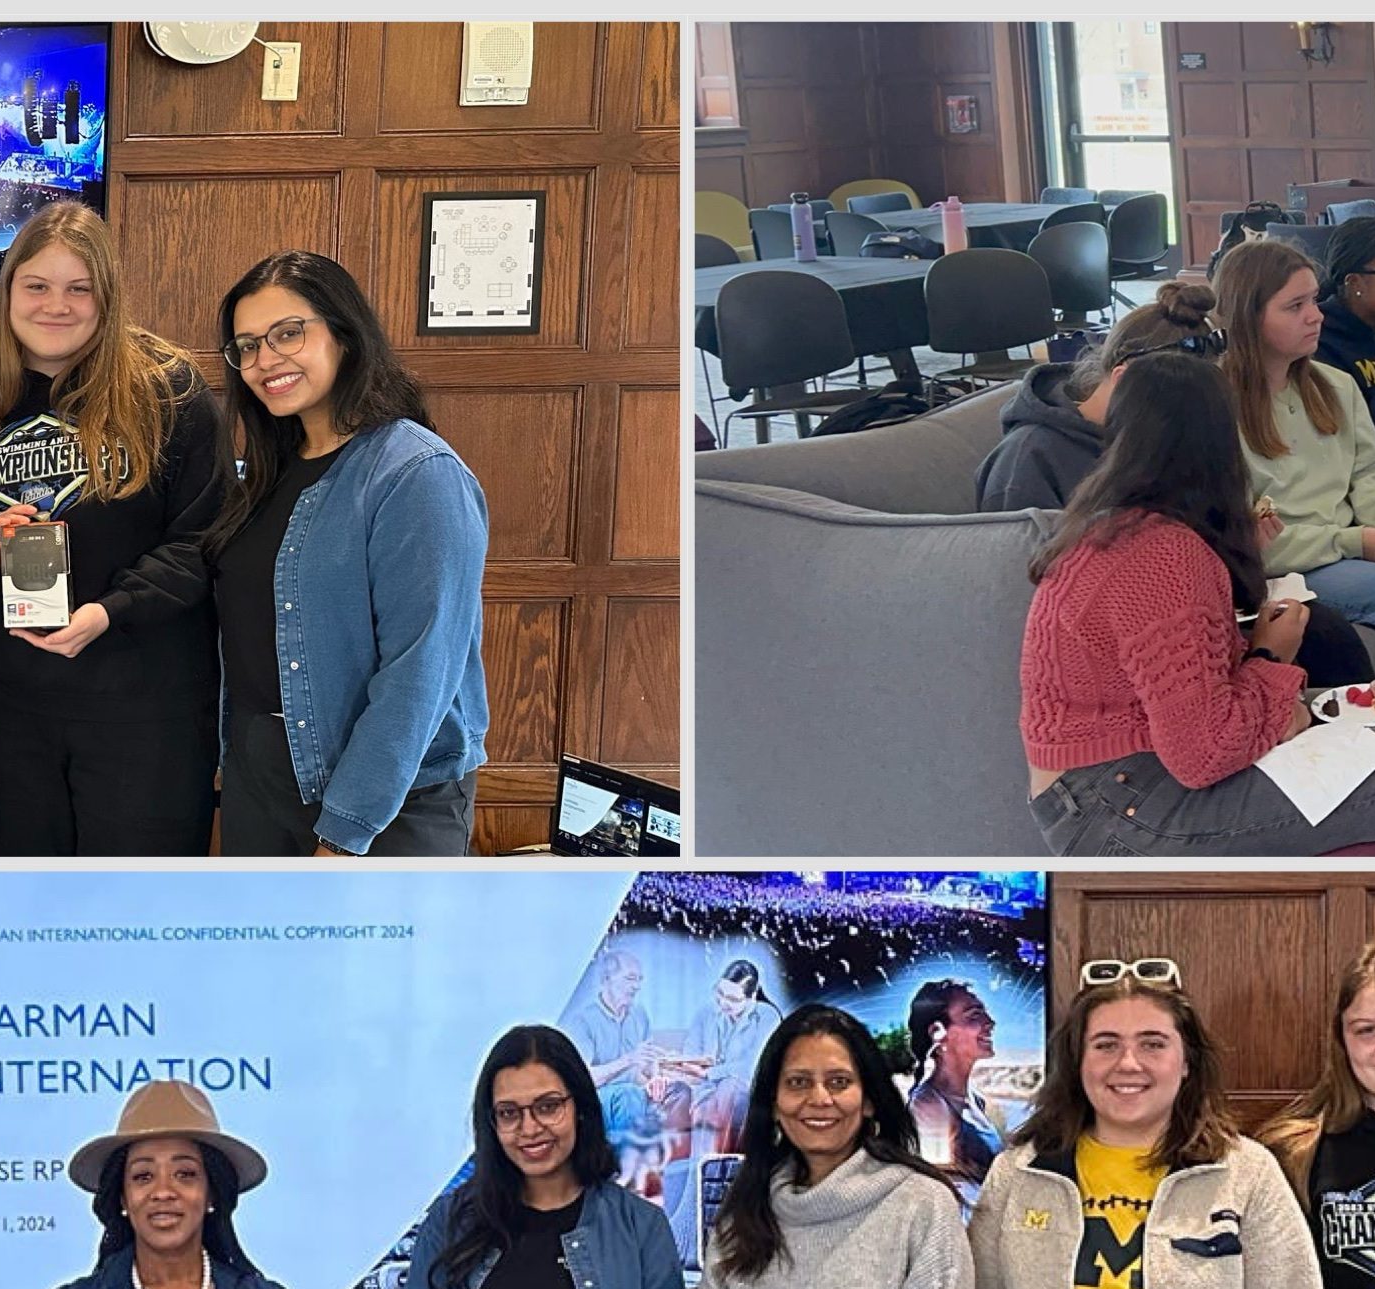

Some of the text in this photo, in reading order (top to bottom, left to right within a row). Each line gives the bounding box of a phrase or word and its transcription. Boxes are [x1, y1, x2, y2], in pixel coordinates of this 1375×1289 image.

[27, 928, 158, 942] INTERNATIONAL
[162, 926, 280, 941] CONFIDENTIAL
[283, 926, 377, 940] COPYRIGHT
[380, 925, 414, 939] 2024
[32, 1160, 65, 1180] RP
[3, 1217, 15, 1234] 1,
[16, 1215, 56, 1232] 2024
[1025, 1209, 1049, 1230] M
